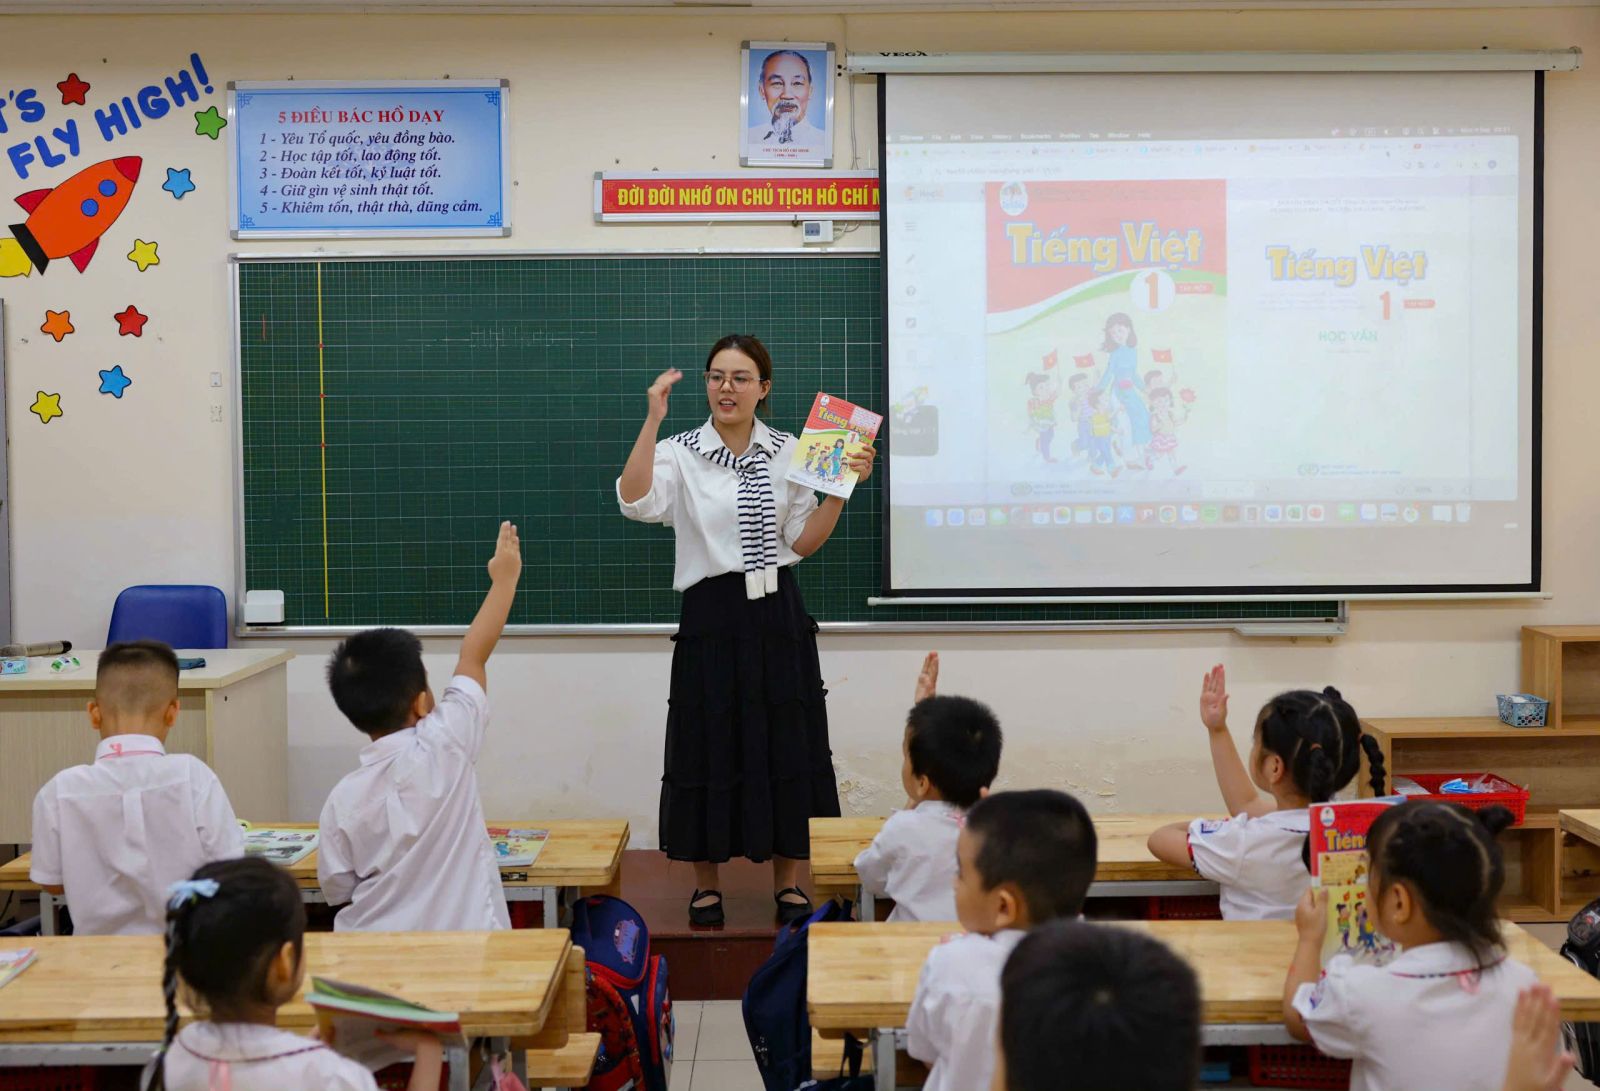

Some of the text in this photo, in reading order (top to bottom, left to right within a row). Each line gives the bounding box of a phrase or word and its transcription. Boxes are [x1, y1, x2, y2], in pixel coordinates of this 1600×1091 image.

[7, 53, 214, 180] FLY HIGH!
[278, 105, 444, 125] 5 ĐIỀU BÁC HỒ DẠY
[260, 132, 267, 144] 1
[281, 132, 304, 144] Yêu
[308, 130, 327, 144] Tổ
[328, 130, 363, 147] quốc,
[367, 132, 389, 146] yêu
[393, 130, 425, 146] đồng
[428, 131, 455, 143] bào.
[259, 150, 267, 161] 2
[280, 150, 308, 164] Học
[311, 150, 332, 164] tập
[335, 147, 357, 162] tốt,
[361, 149, 381, 161] lao
[384, 149, 416, 163] động
[420, 147, 441, 161] tốt.
[259, 167, 267, 179] 3
[281, 167, 317, 179] Đoàn
[320, 164, 341, 179] kết
[345, 164, 366, 180] tốt,
[390, 166, 416, 180] luật
[420, 164, 441, 178] tốt.
[260, 185, 268, 196] 4
[281, 184, 307, 197] Giữ
[308, 184, 329, 199] gìn
[333, 183, 347, 198] vệ
[349, 184, 377, 196] sinh
[381, 183, 408, 198] thật
[412, 181, 434, 195] tốt.
[618, 184, 644, 207] ĐỜI
[648, 184, 675, 207] ĐỜI
[679, 186, 712, 207] NHỚ
[716, 186, 738, 206] ƠN
[742, 182, 772, 207] CHỦ
[777, 187, 812, 209] TỊCH
[817, 182, 837, 206] HỒ
[842, 185, 868, 206] CHÍ
[260, 201, 268, 214] 5
[281, 201, 324, 214] Khiêm
[328, 199, 353, 214] tốn,
[357, 201, 384, 215] thật
[387, 200, 413, 213] thà,
[416, 200, 450, 214] dũng
[452, 200, 483, 212] cảm.
[1006, 220, 1203, 274] Tiếng Việt
[1266, 244, 1428, 287] Tiếng Việt
[1144, 272, 1159, 309] 1
[1379, 291, 1391, 320] 1
[818, 406, 849, 429] Tiếng
[1323, 828, 1367, 851] Tiến
